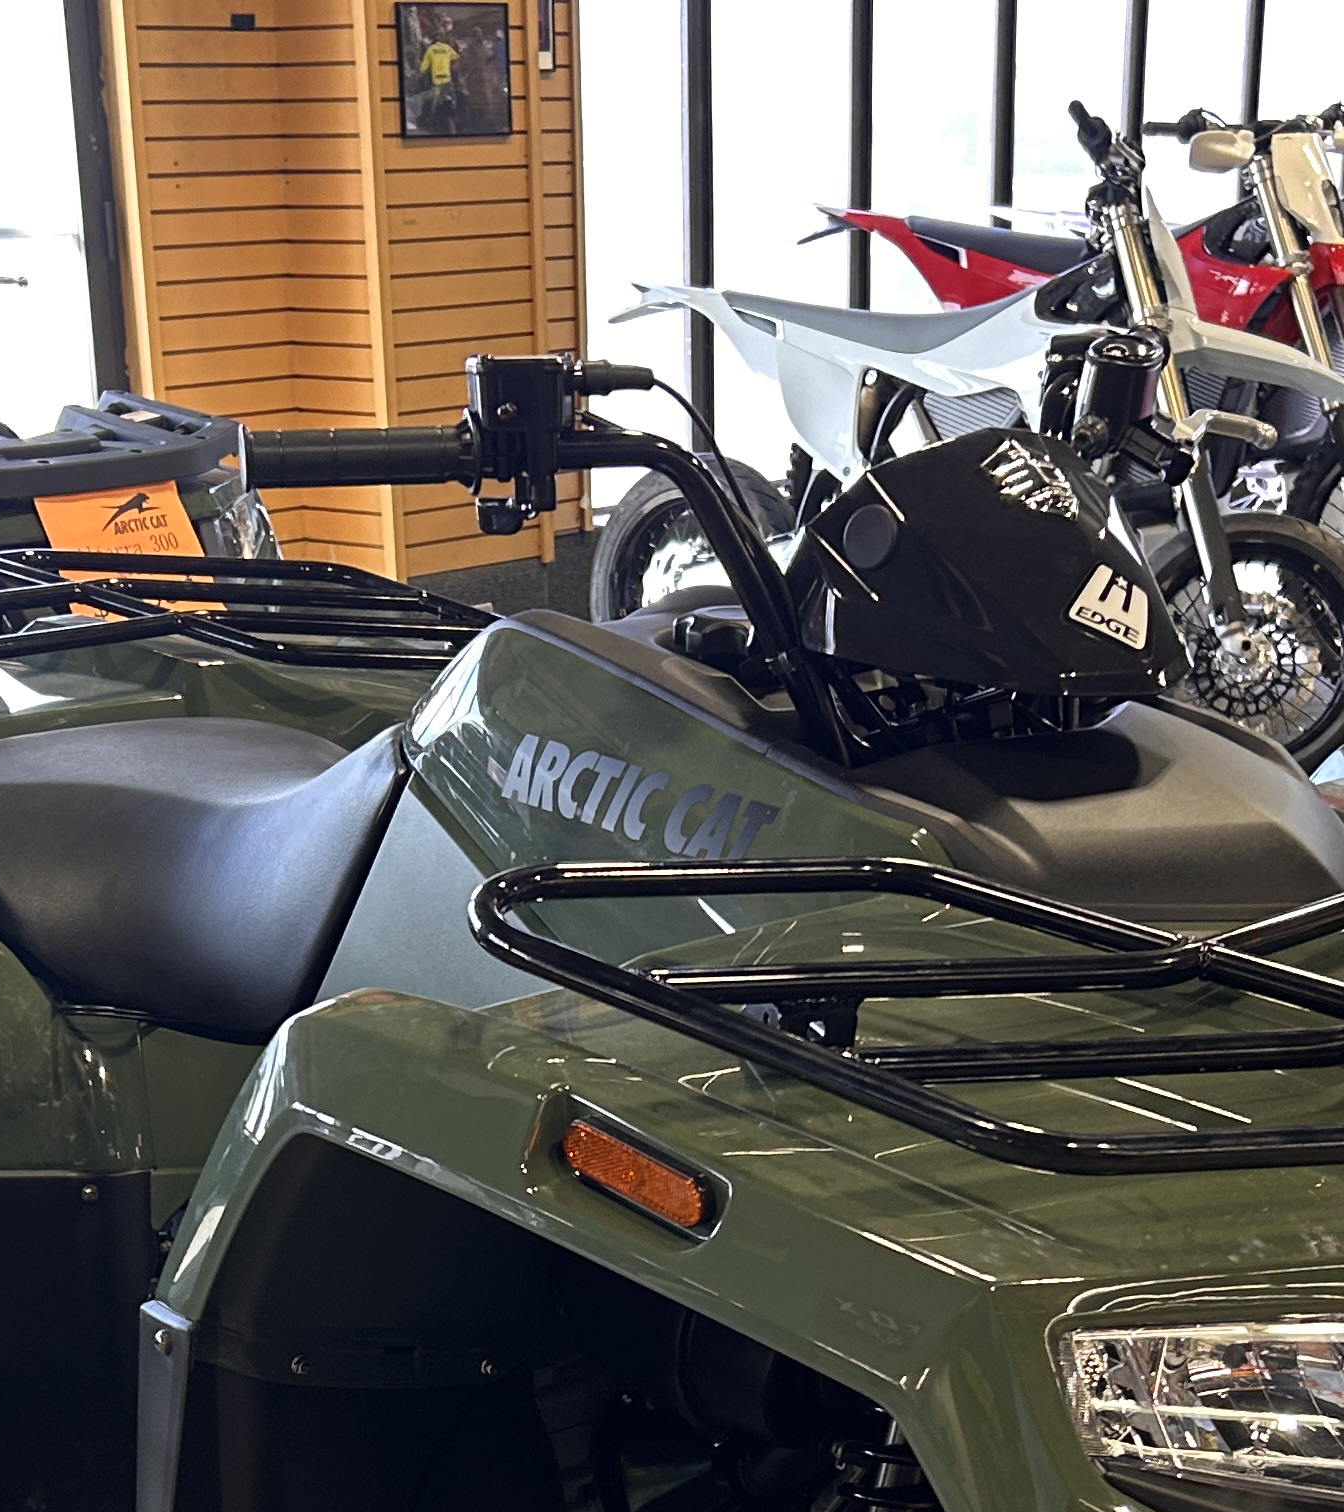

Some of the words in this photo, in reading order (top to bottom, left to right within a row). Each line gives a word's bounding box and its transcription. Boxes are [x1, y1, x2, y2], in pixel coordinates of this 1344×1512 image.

[114, 517, 149, 535] ARCTIC
[150, 514, 168, 529] CAT
[150, 532, 179, 552] 300
[1075, 606, 1140, 645] EDGE
[501, 733, 670, 841] ARCTIC
[663, 783, 781, 860] CAT
